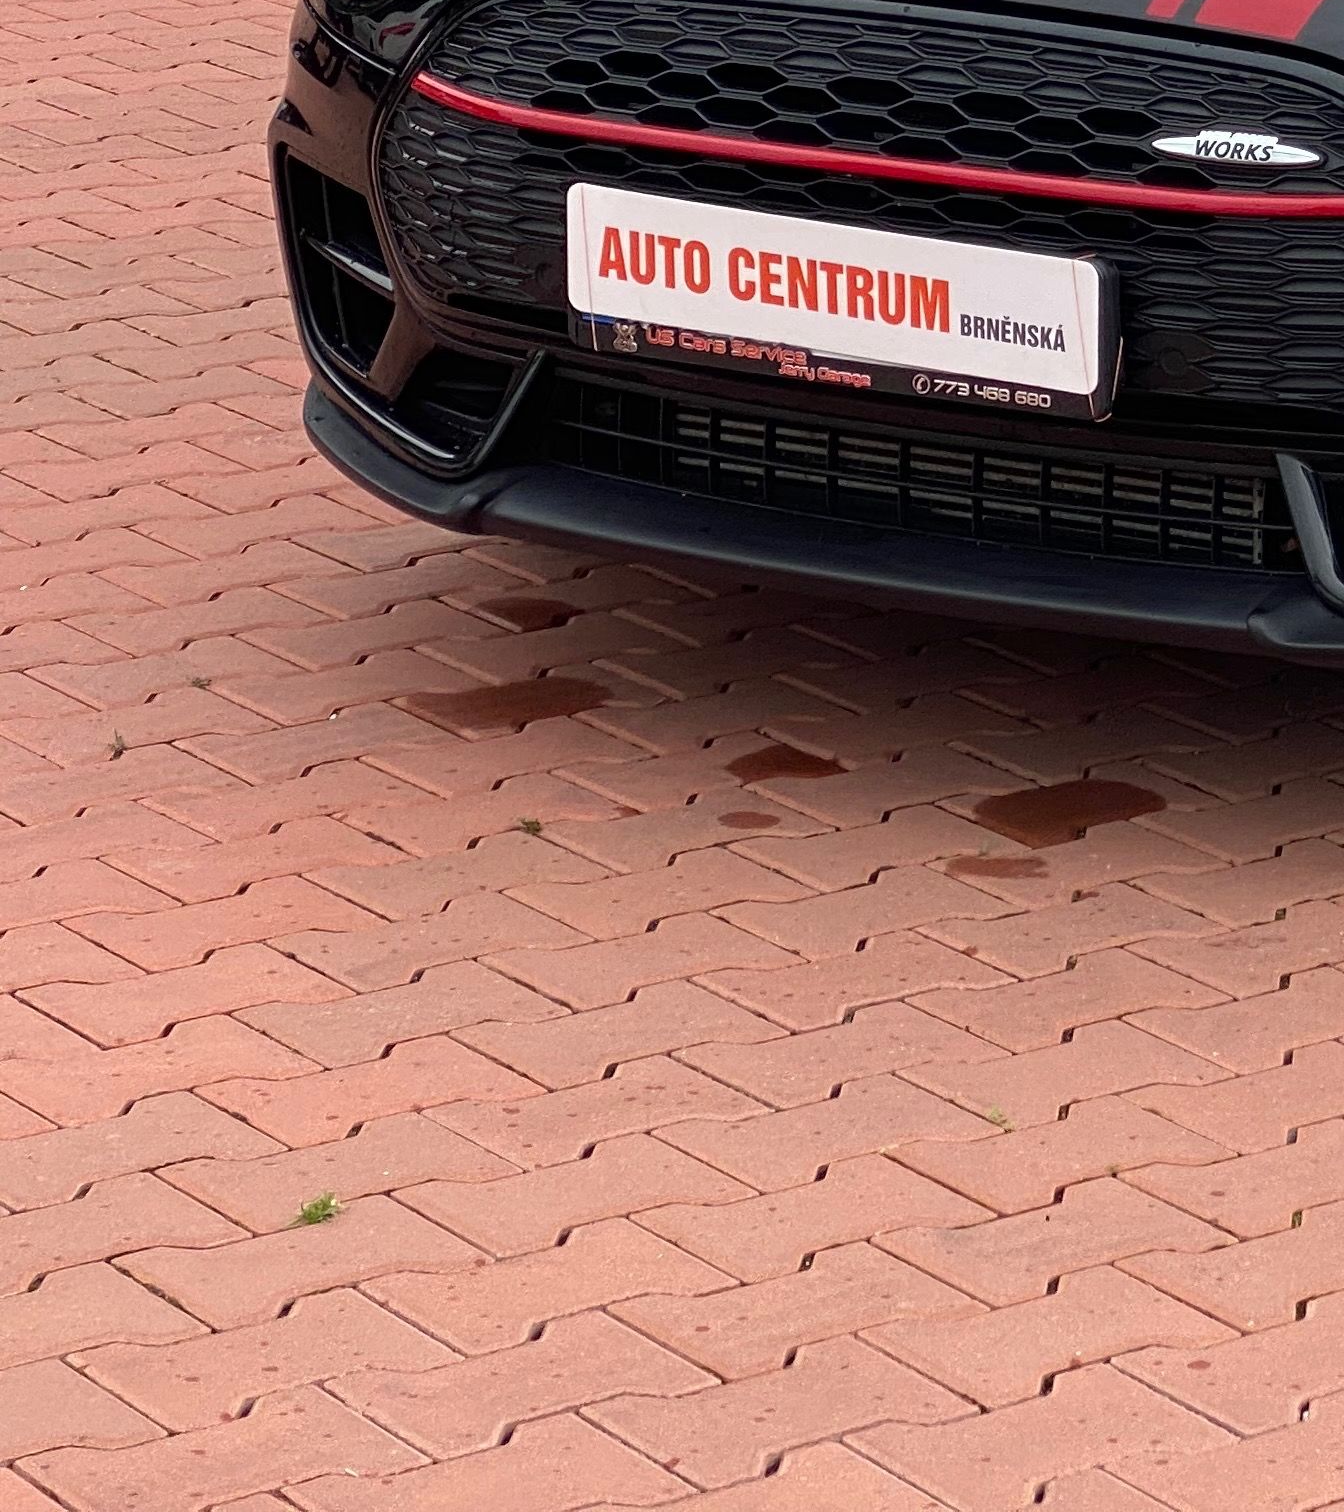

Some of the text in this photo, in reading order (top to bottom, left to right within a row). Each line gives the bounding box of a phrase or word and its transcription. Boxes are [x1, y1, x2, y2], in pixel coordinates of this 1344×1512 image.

[1194, 139, 1274, 162] WORKS
[598, 226, 1067, 353] AUTO CENTRUM BRNĚNSKÁ
[645, 325, 808, 365] US Cars Service
[779, 362, 872, 388] Jerry Garage
[932, 378, 1052, 409] 773 468 680
